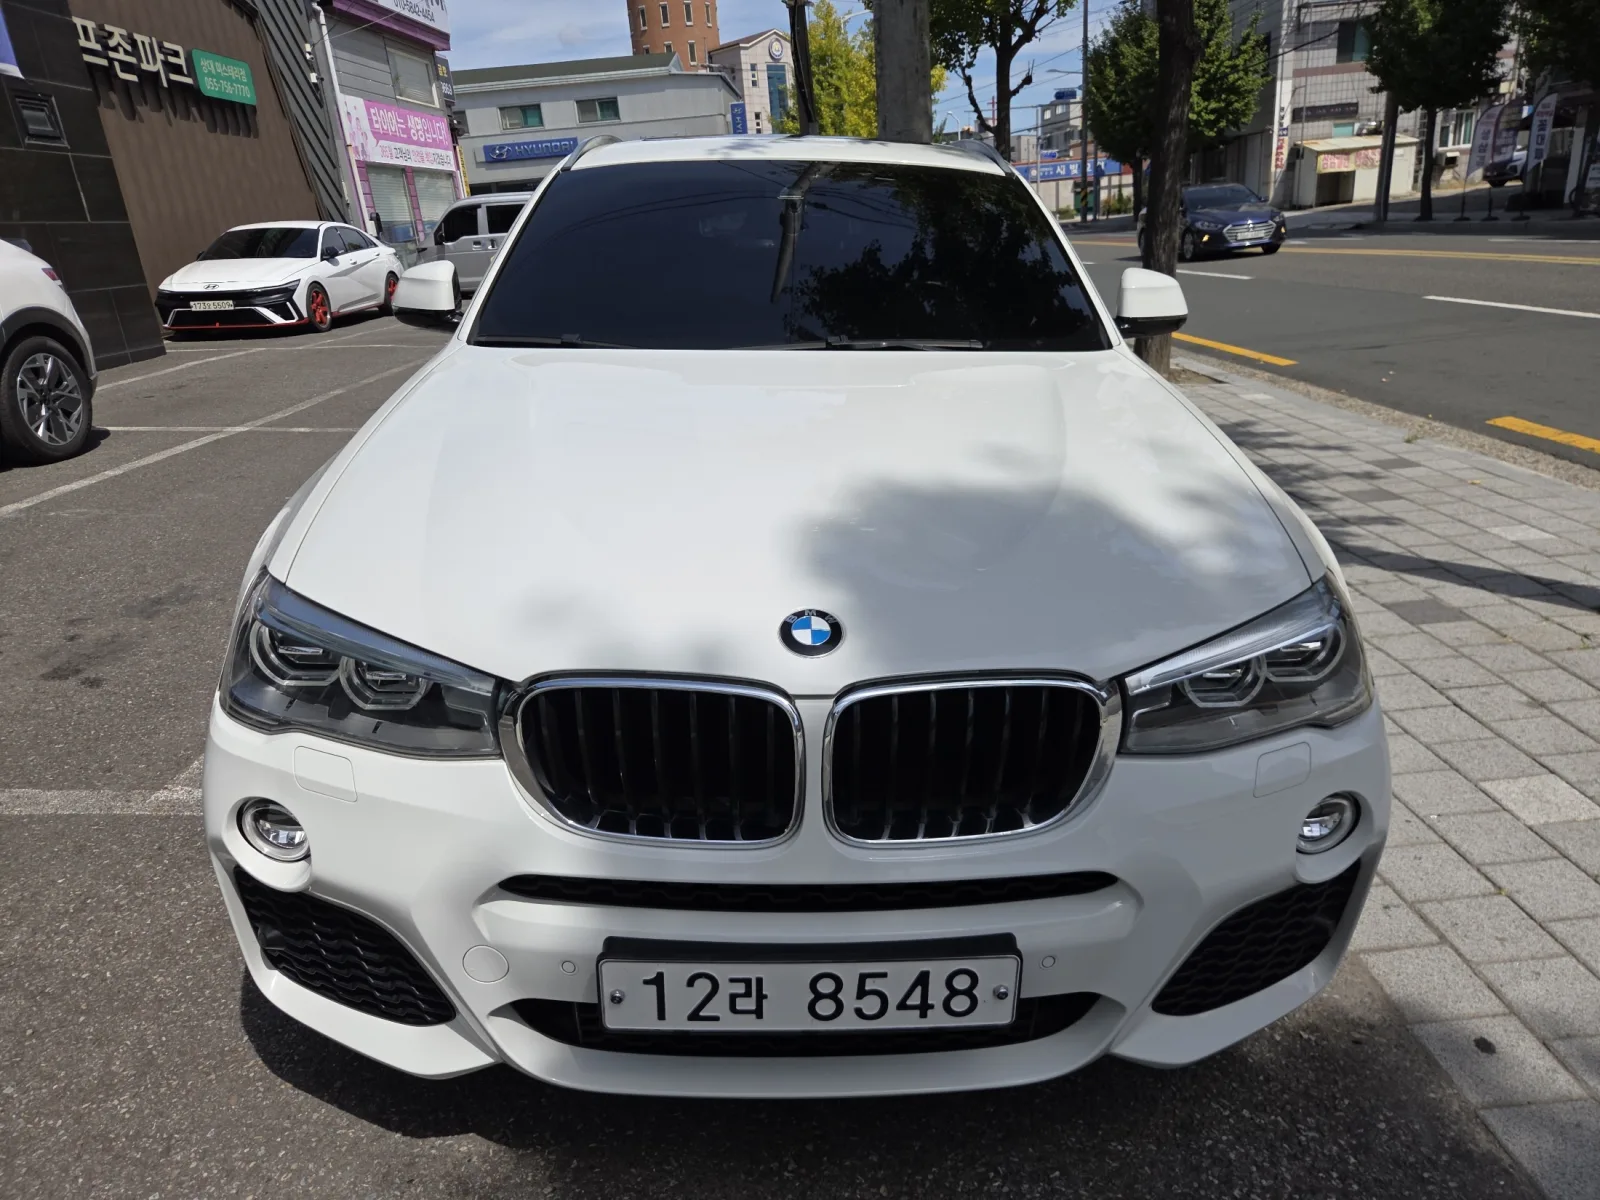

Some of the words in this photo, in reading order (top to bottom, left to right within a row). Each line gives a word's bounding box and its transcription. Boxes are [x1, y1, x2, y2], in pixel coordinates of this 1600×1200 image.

[72, 15, 194, 88] 프존파크
[204, 76, 251, 98] 055-756-7770
[370, 107, 407, 138] 타이어는
[407, 114, 449, 145] 생명입니다!
[515, 140, 575, 157] HYUNDAI
[212, 301, 231, 309] 5509
[641, 970, 769, 1022] 12라
[806, 967, 980, 1022] 8548
